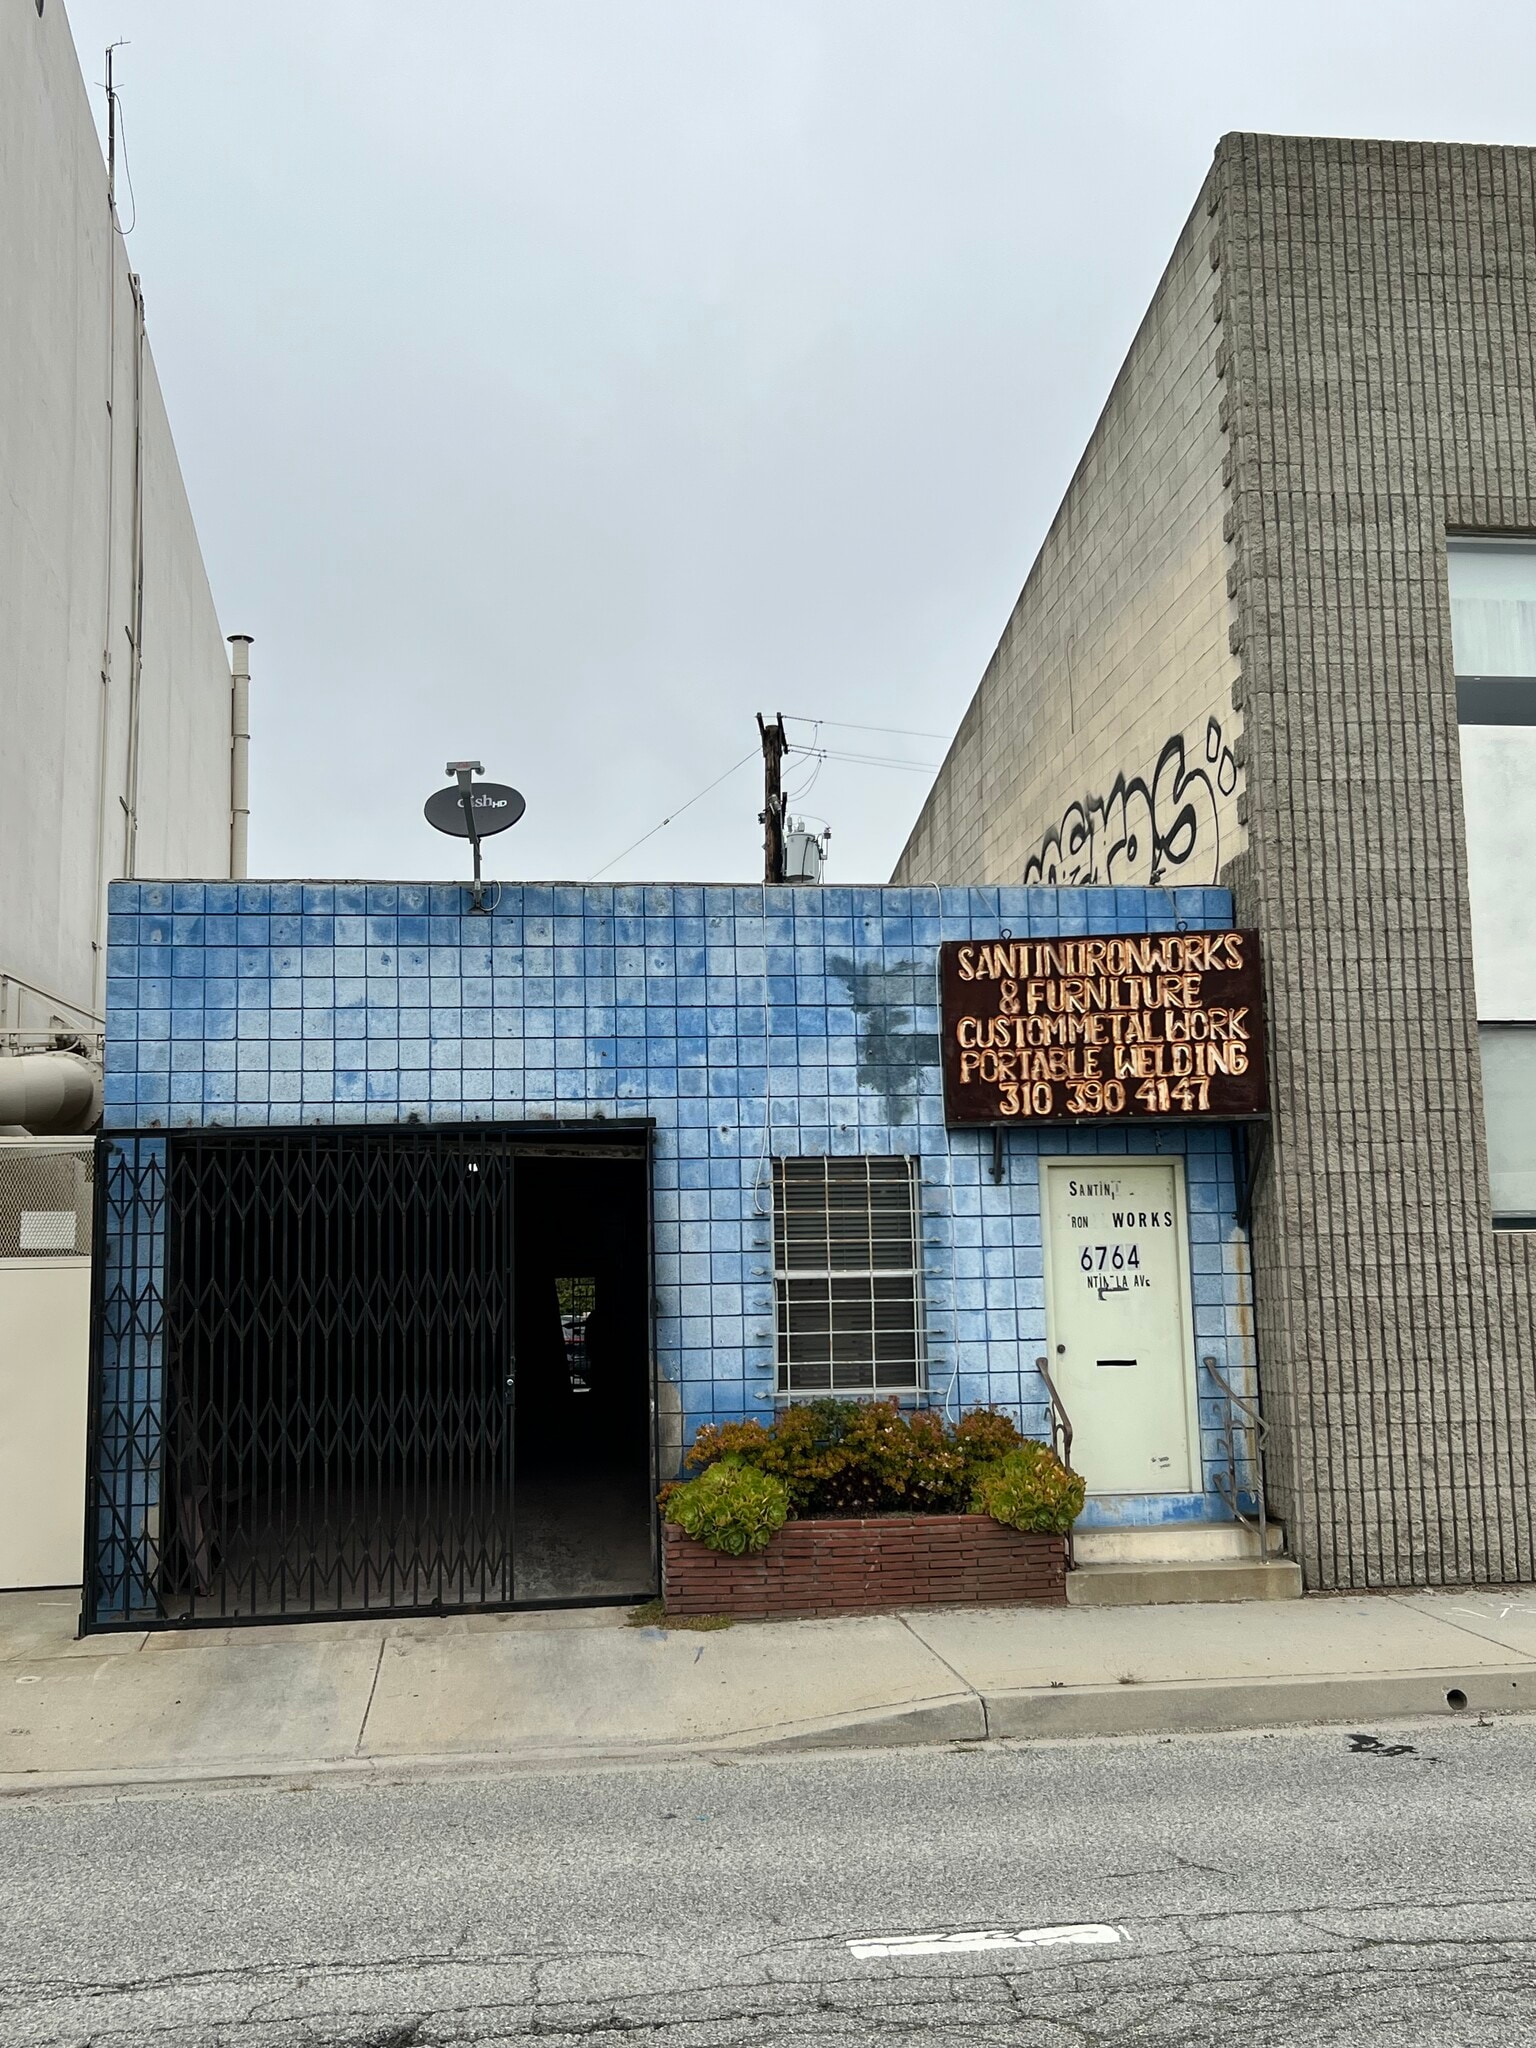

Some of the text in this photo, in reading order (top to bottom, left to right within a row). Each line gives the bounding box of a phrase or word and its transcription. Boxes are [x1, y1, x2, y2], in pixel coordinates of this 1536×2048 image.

[999, 973, 1203, 1014] & FURNITURE
[1164, 1008, 1250, 1042] WORK
[960, 1040, 1249, 1084] PORTABLE WELDING
[999, 1076, 1211, 1115] 310 390 4147
[1112, 1211, 1172, 1228] WORKS
[1081, 1245, 1140, 1271] 6764
